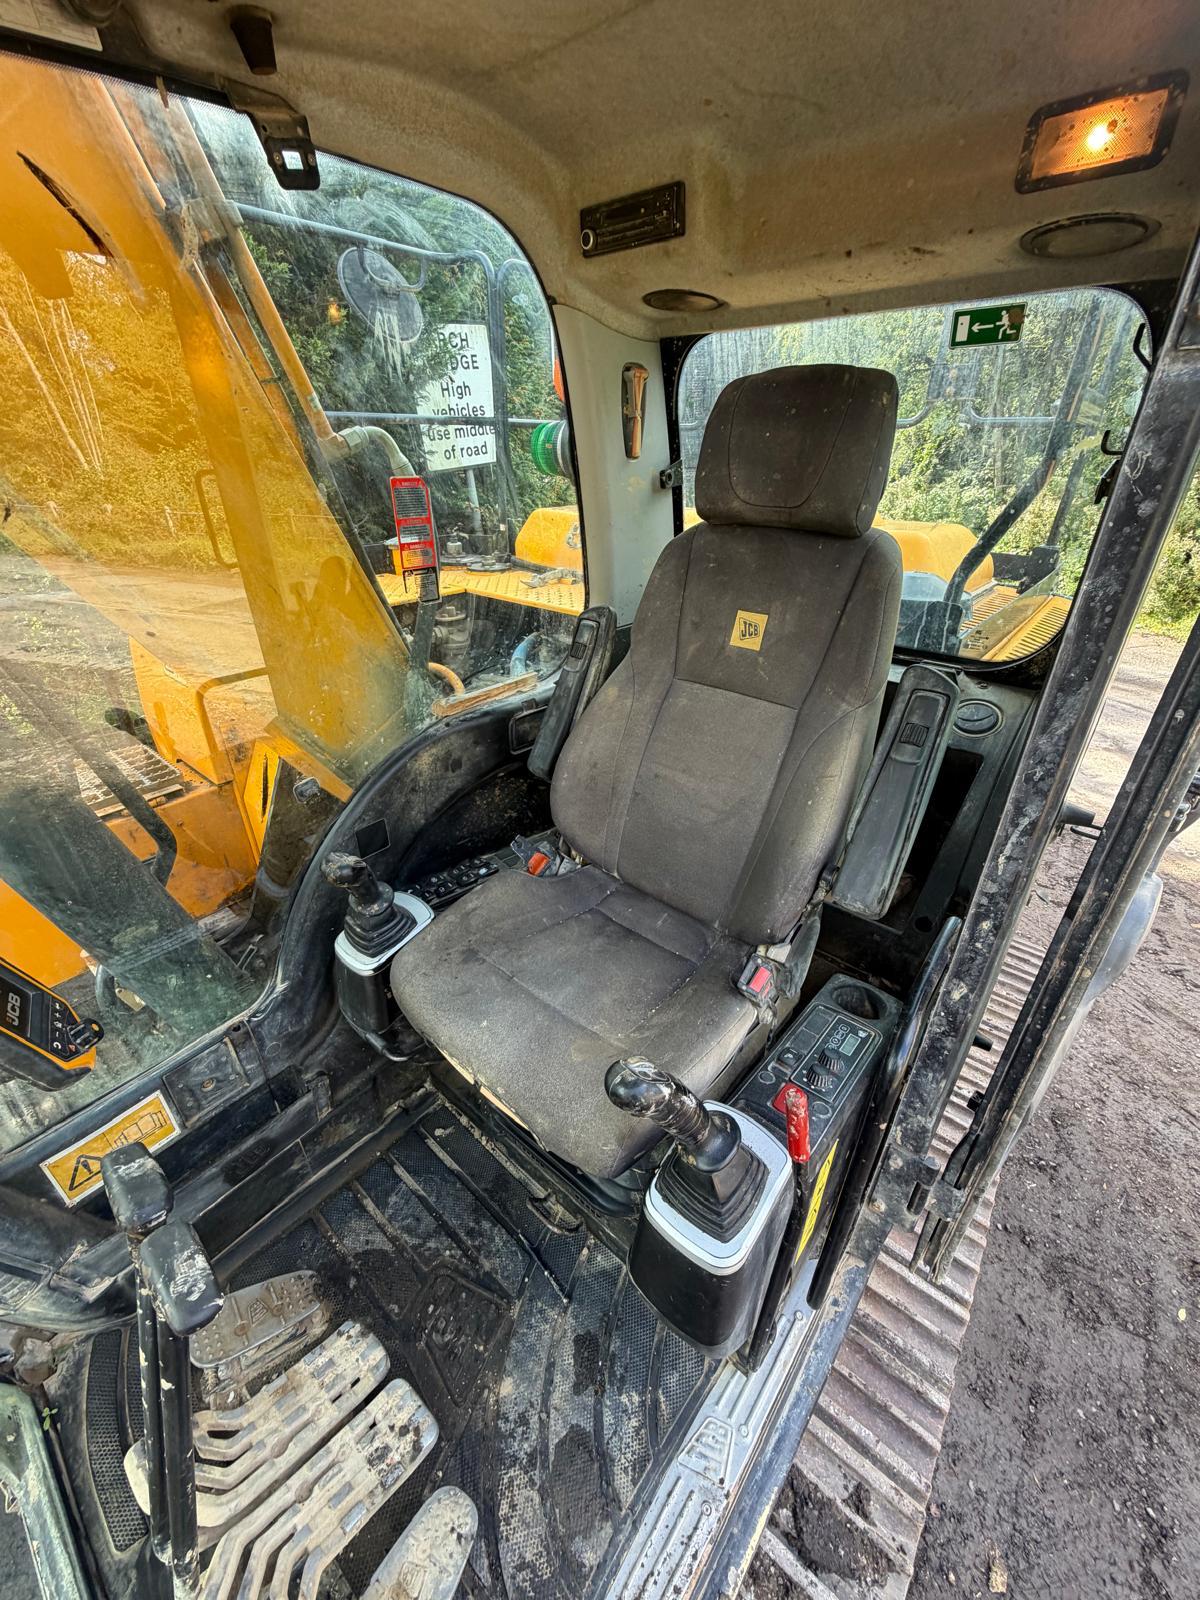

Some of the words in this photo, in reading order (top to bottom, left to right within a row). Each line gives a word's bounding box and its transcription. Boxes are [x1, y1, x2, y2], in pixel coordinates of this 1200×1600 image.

[437, 331, 470, 348] RCH
[450, 354, 480, 370] DGE
[440, 381, 472, 399] High
[432, 404, 486, 417] vehicles
[428, 428, 451, 441] use
[455, 424, 496, 439] middle
[443, 445, 457, 460] of
[460, 441, 488, 458] road
[741, 620, 759, 638] JCB
[7, 992, 21, 1026] JCB
